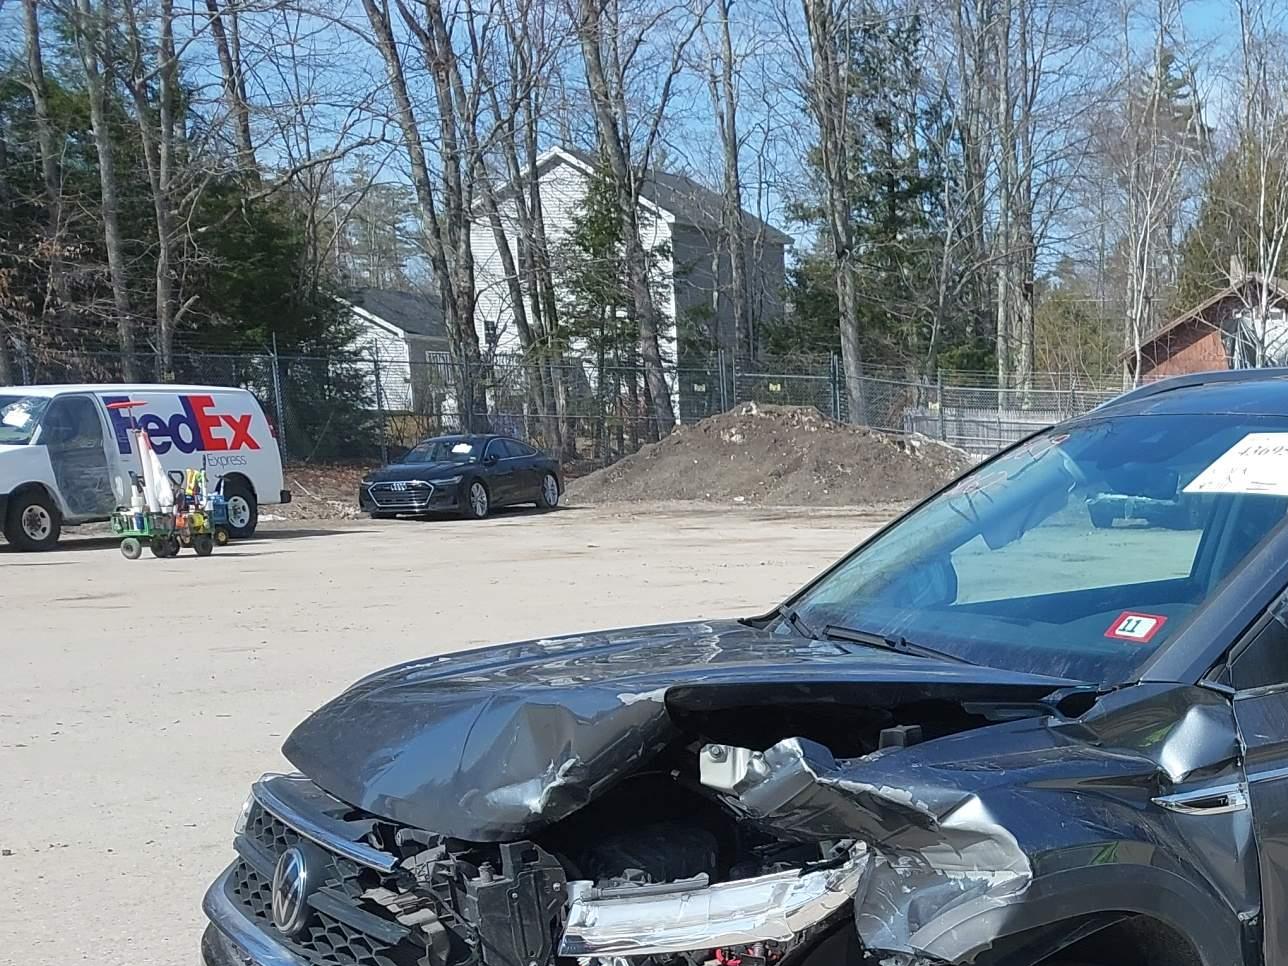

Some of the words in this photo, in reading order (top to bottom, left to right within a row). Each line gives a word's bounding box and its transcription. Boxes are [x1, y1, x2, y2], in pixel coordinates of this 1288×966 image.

[101, 395, 261, 455] FedEx
[206, 453, 248, 467] Express
[1118, 618, 1142, 633] 11
